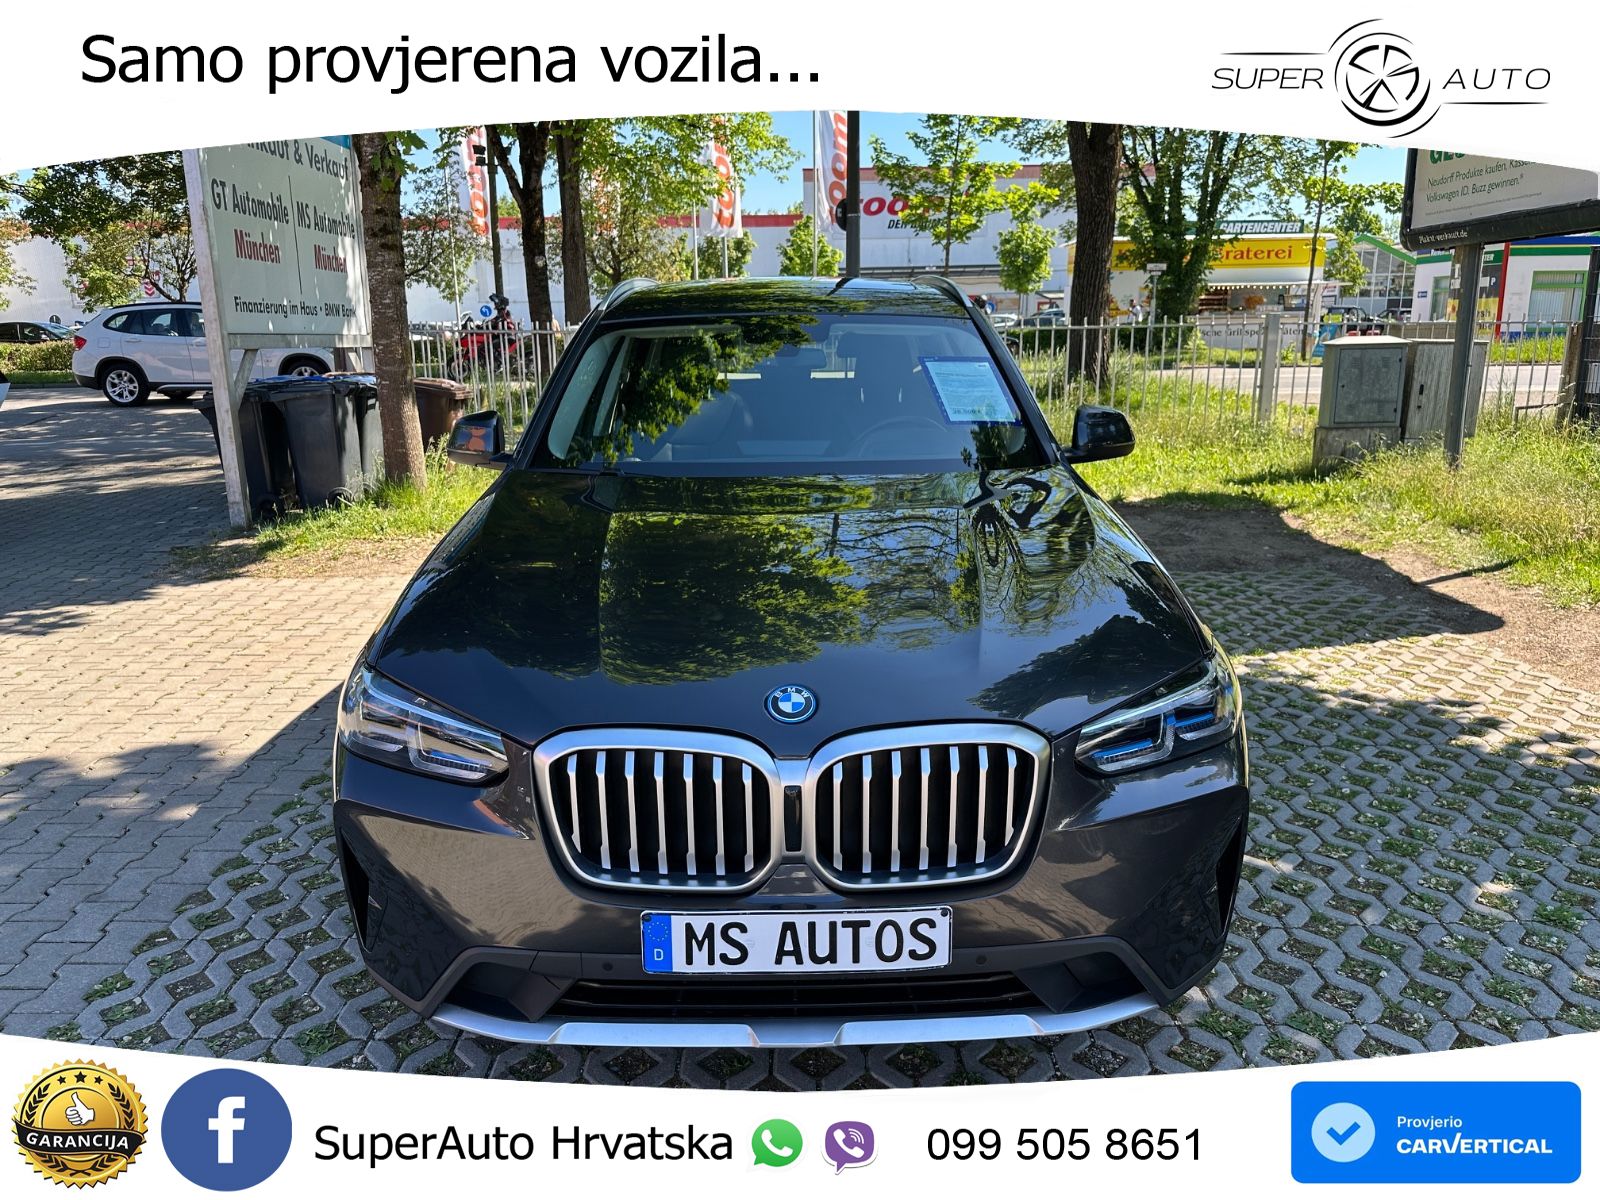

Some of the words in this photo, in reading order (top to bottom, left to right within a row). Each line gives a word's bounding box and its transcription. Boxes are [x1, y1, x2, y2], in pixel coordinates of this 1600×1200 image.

[247, 140, 290, 160] kauf
[293, 139, 303, 166] &
[304, 142, 349, 181] Verkauf
[1426, 190, 1459, 202] Volkswagen
[1471, 183, 1487, 194] Buzz
[1428, 172, 1456, 189] Neudorff
[1455, 169, 1483, 181] Produkte
[211, 177, 228, 211] GT
[232, 183, 290, 225] Automobile
[296, 201, 311, 230] MS
[314, 205, 355, 239] Automobile
[1220, 221, 1302, 233] GARTENCENTER
[234, 229, 281, 264] München
[313, 243, 348, 273] München
[233, 295, 288, 319] Finanzierung
[289, 301, 299, 315] im
[300, 301, 318, 316] Haus
[324, 302, 342, 317] BMW
[342, 302, 356, 317] Bank
[775, 687, 810, 698] BMW
[653, 948, 664, 961] D
[685, 921, 749, 966] MS
[774, 917, 937, 965] AUTOS
